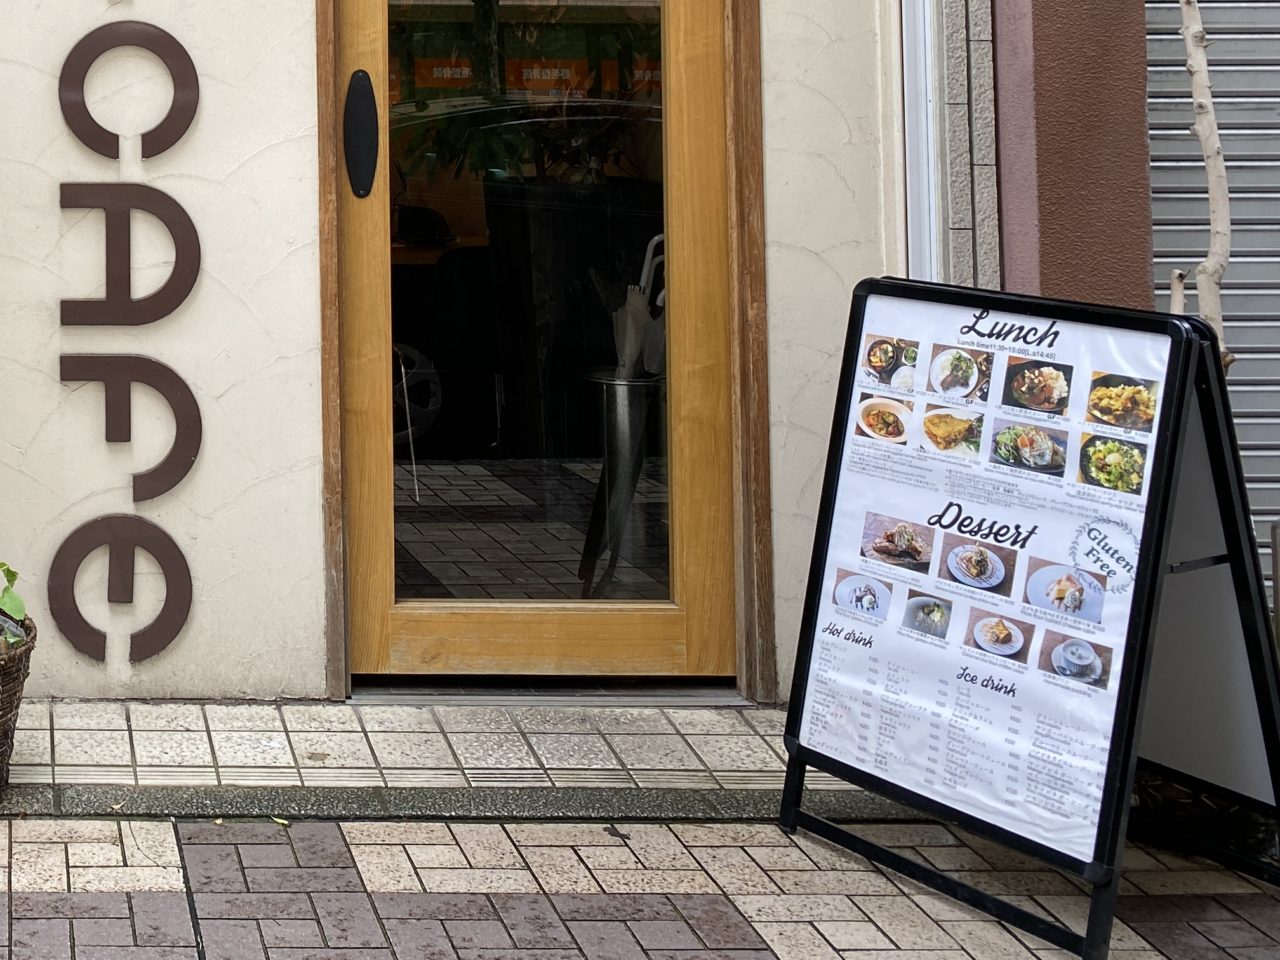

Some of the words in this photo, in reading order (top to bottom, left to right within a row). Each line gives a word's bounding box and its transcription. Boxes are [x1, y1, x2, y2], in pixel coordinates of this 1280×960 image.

[957, 339, 975, 347] Lunch
[959, 309, 1061, 348] Lunch
[927, 501, 1039, 550] Dessert
[1084, 545, 1117, 579] Free
[1086, 527, 1134, 574] Gluten
[822, 622, 843, 637] Hot
[844, 629, 874, 648] drink
[956, 665, 978, 685] Ice
[981, 675, 1018, 697] drink
